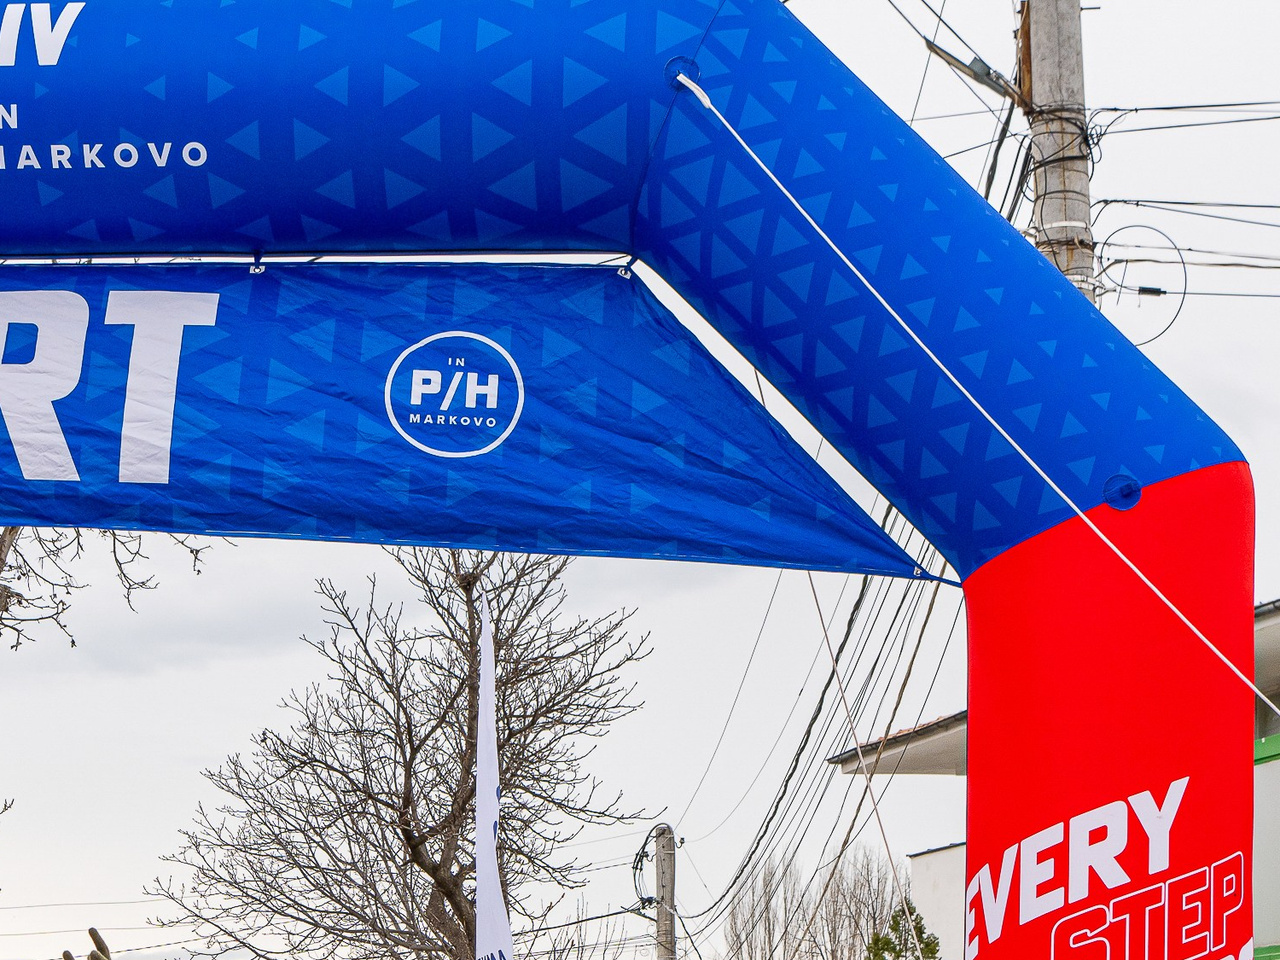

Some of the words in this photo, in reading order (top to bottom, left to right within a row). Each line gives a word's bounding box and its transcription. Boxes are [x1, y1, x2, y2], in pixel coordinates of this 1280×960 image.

[448, 357, 465, 367] IN
[410, 369, 499, 411] P/H
[409, 413, 497, 428] MARKOVO
